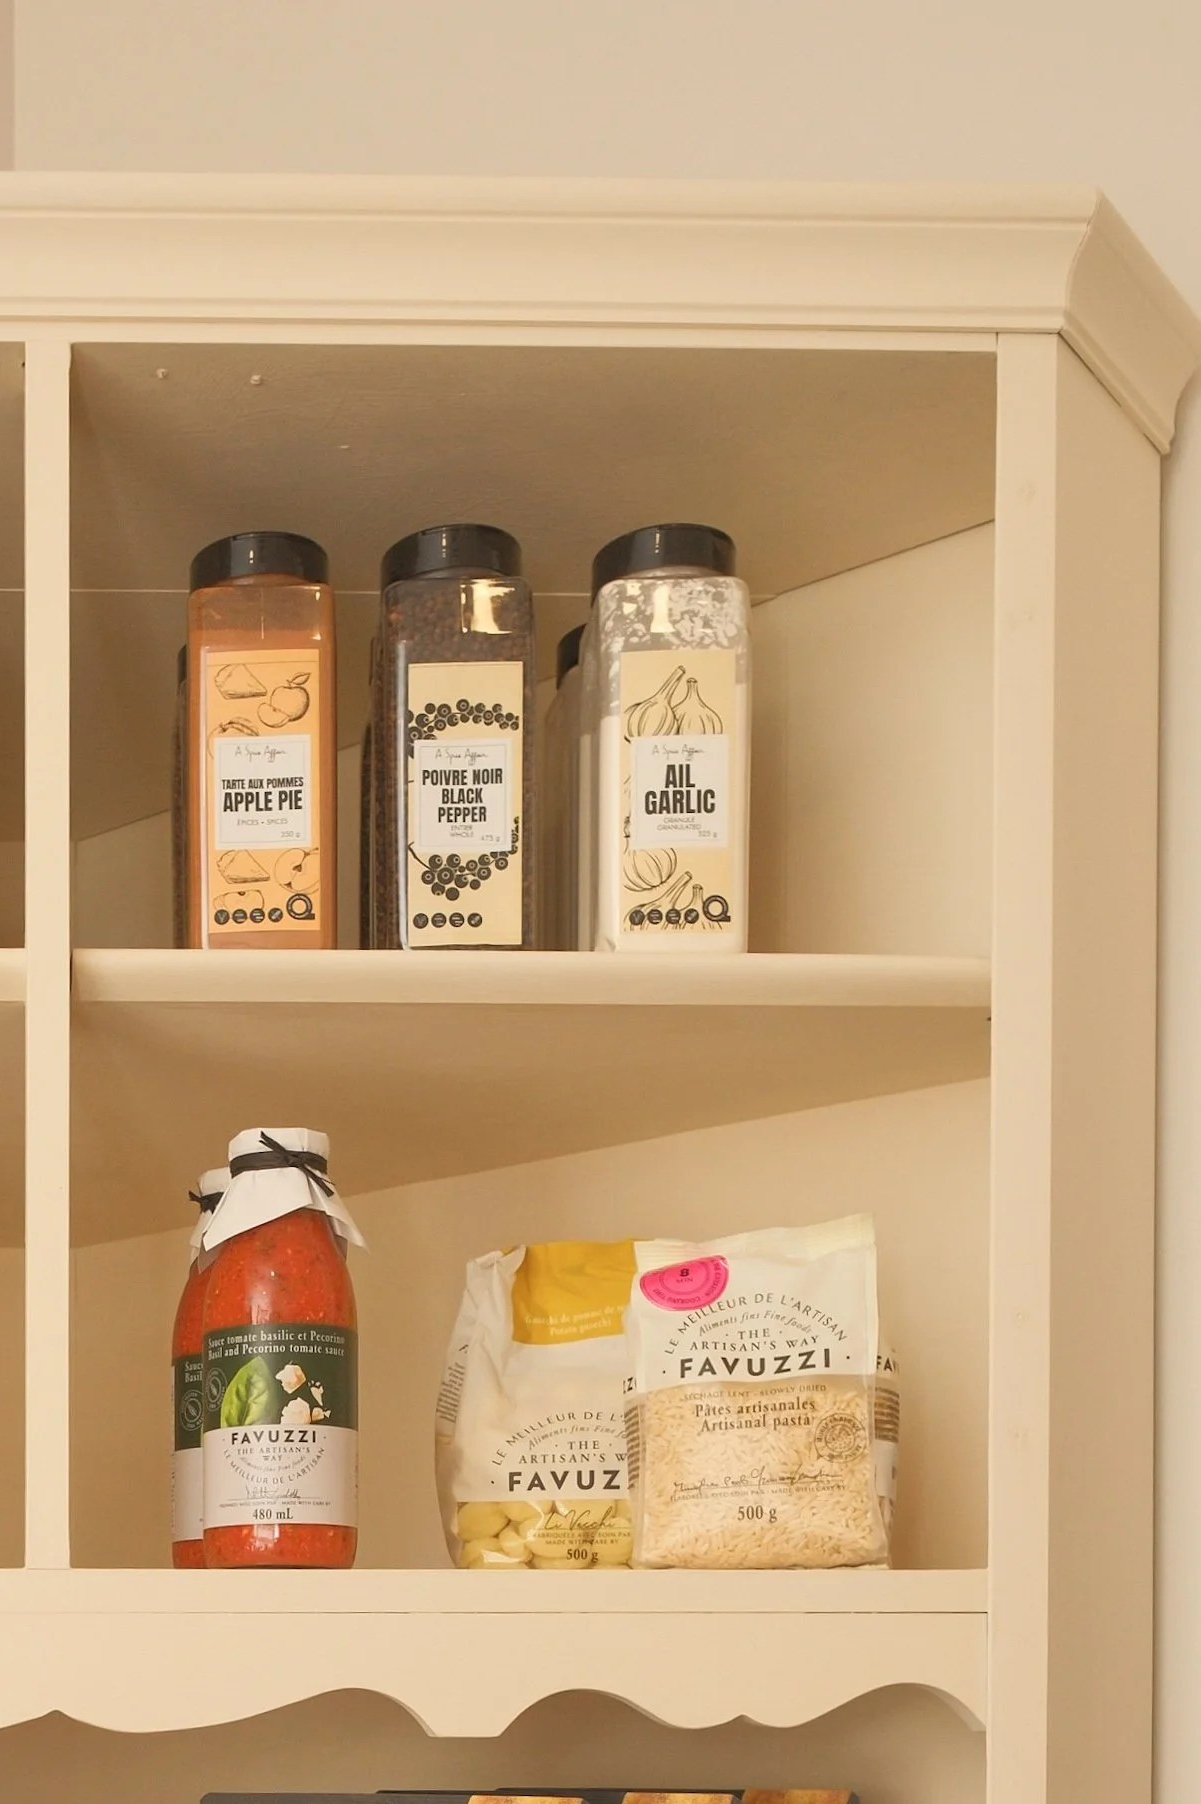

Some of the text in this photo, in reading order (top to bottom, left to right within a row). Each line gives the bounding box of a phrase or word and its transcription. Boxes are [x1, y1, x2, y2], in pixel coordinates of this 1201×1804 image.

[222, 777, 304, 790] TARTE AUX POMMES
[422, 768, 503, 785] POIVRE NOIR
[665, 764, 696, 788] AIL
[223, 790, 302, 812] APPLE PIE
[441, 788, 483, 804] BLACK
[645, 789, 716, 815] GARLIC
[438, 807, 487, 822] PEPPER
[664, 1293, 847, 1355] LE MEILLEUR DE L'ARTISAN
[208, 1330, 345, 1349] Sauce tomate basilic et Pecorino
[738, 1328, 771, 1340] THE
[208, 1343, 286, 1360] Basil and Pecorino
[690, 1335, 820, 1352] ARTISAN'S WAY
[680, 1348, 830, 1378] FAVUZZI
[799, 1384, 827, 1393] DRIED
[695, 1397, 815, 1418] Pâtes artisanales
[701, 1415, 810, 1433] Artisanal pasta
[231, 1430, 317, 1445] FAVUZZI
[492, 1411, 603, 1466] LE MEILLEUR DE
[529, 1428, 567, 1450] Aliments
[567, 1440, 600, 1450] THE
[519, 1453, 606, 1464] ARTISAN'S
[272, 1477, 284, 1485] DE
[252, 1508, 294, 1520] 480 mL
[737, 1505, 763, 1520] 500
[566, 1548, 598, 1563] 500 g
